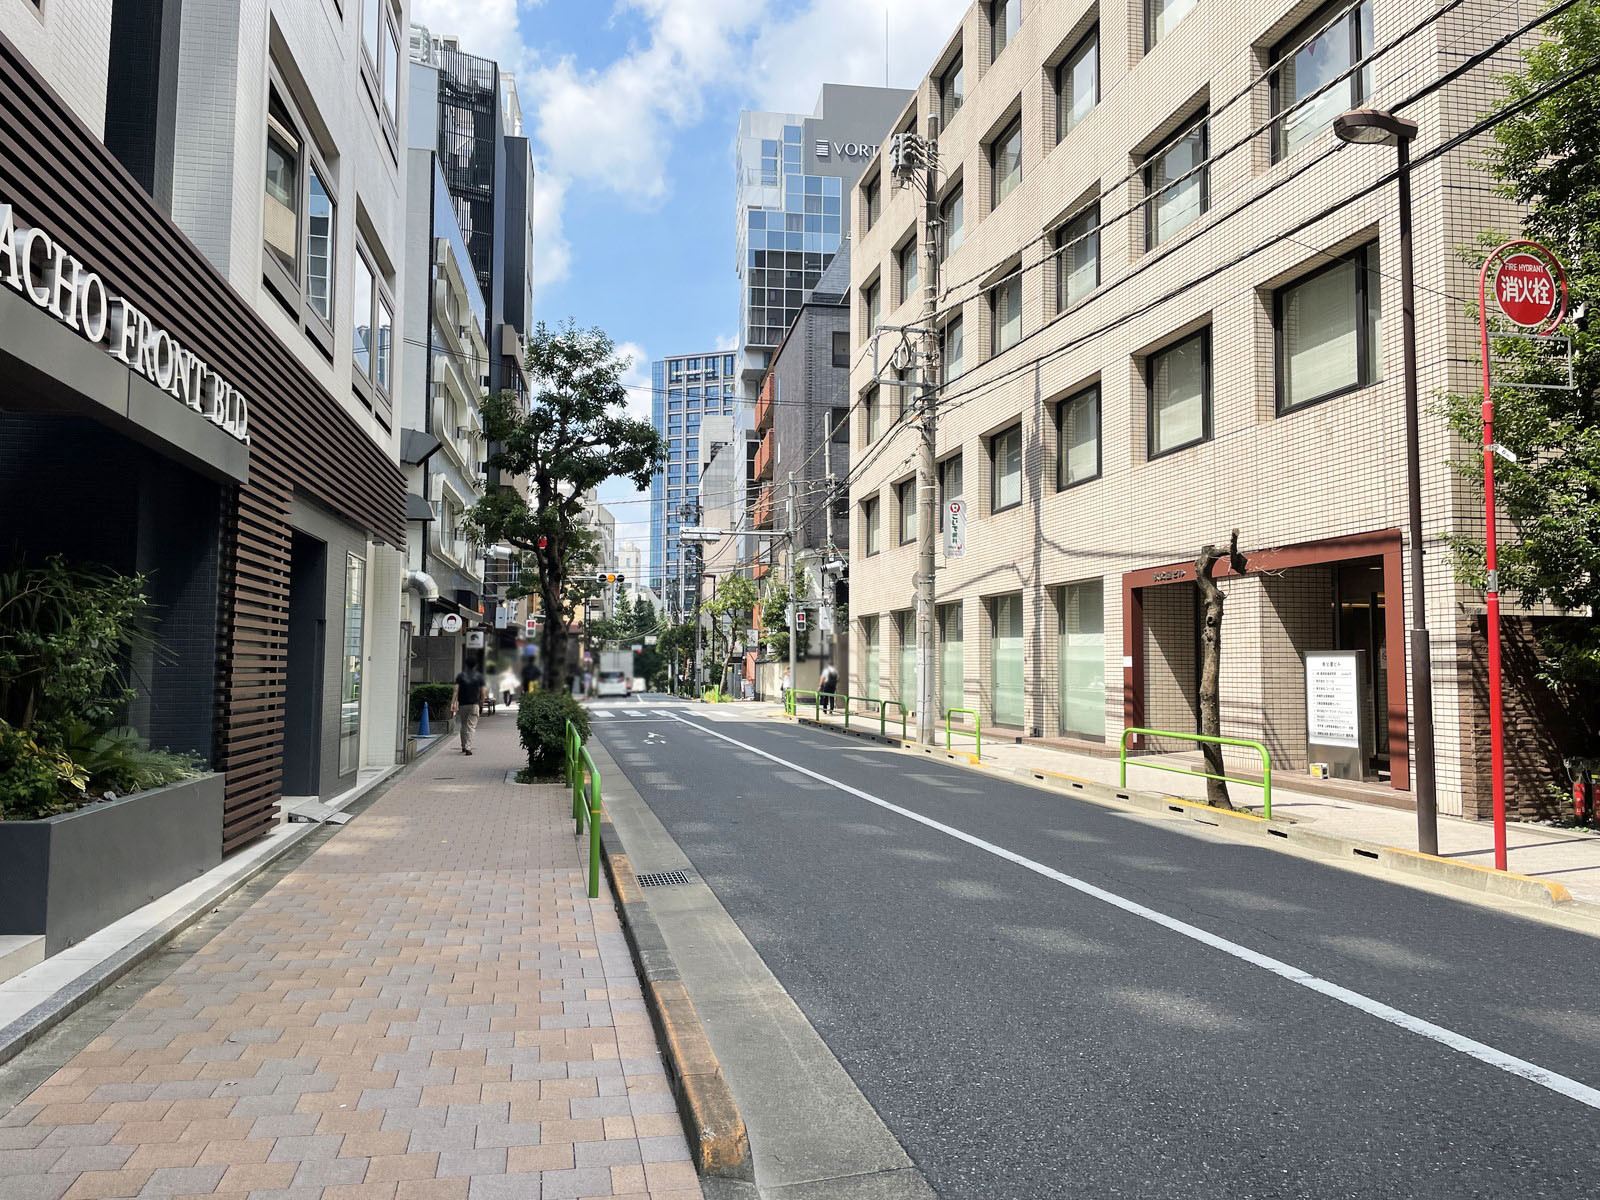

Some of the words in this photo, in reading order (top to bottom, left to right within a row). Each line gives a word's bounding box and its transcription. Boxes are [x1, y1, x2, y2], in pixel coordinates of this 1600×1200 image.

[833, 142, 879, 157] VORT
[1504, 263, 1518, 272] FIRE
[1518, 263, 1544, 274] HYDRANT
[1501, 275, 1550, 305] 消火栓
[0, 203, 107, 342] ACHO
[109, 296, 207, 413] FRONT
